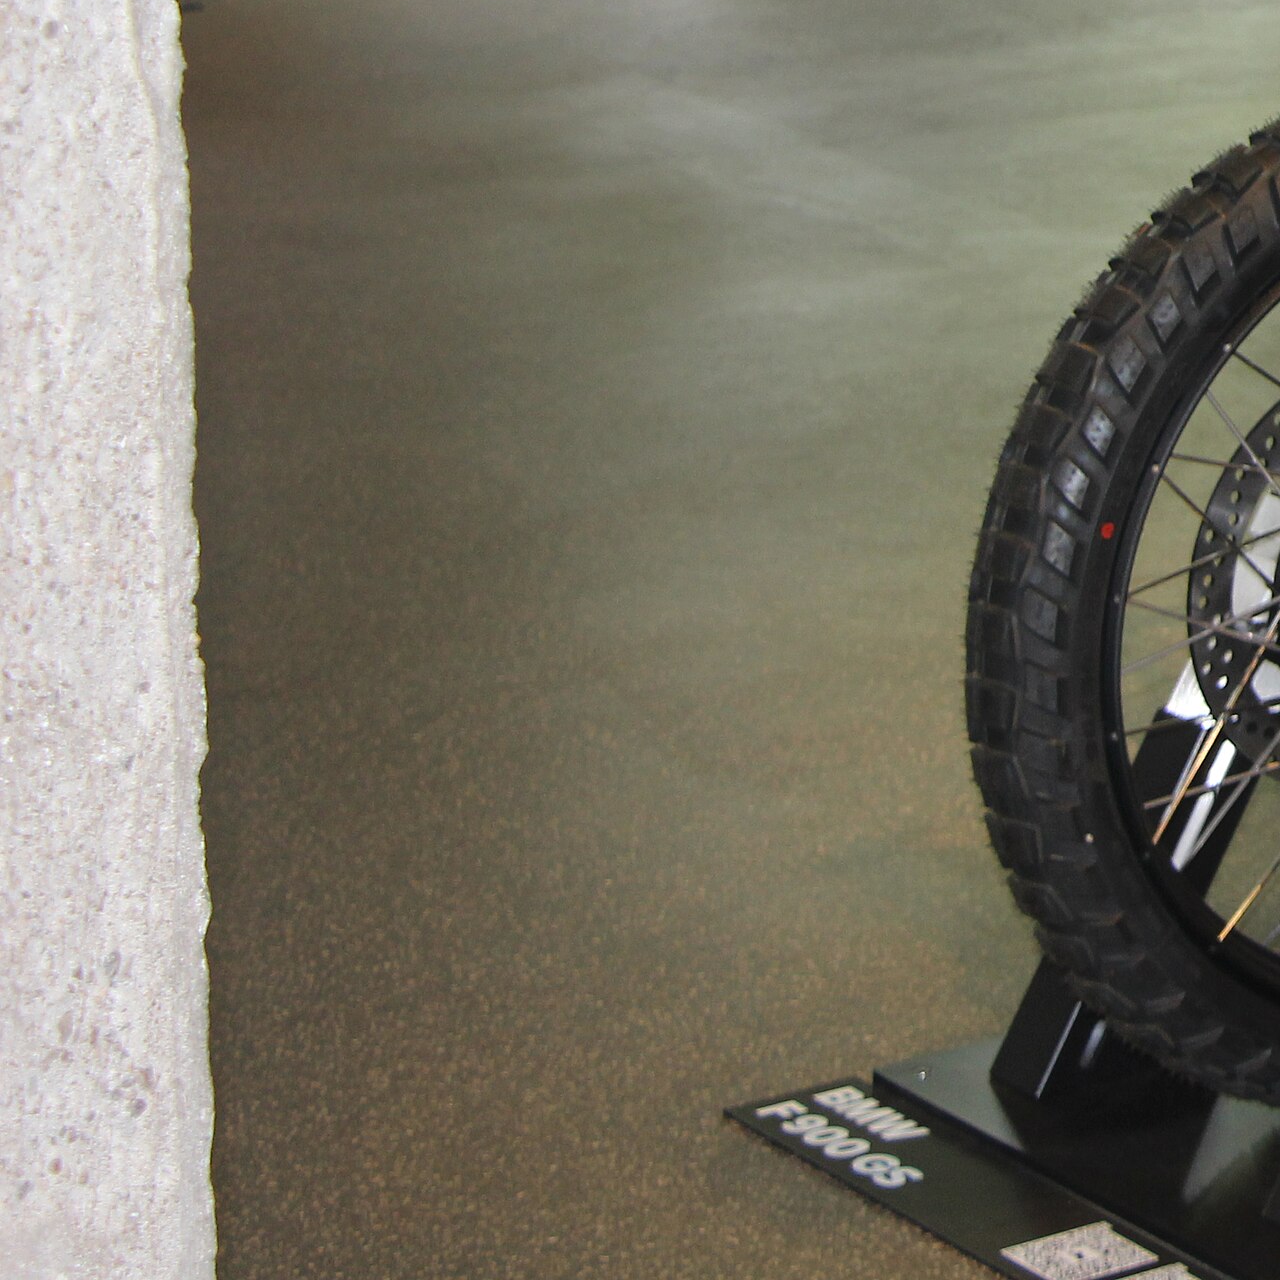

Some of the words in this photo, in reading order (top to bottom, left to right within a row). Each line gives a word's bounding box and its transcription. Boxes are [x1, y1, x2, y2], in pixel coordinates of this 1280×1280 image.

[755, 1099, 808, 1119] F
[782, 1114, 871, 1160] 900
[852, 1153, 924, 1189] GS
[813, 1085, 931, 1141] BMW
